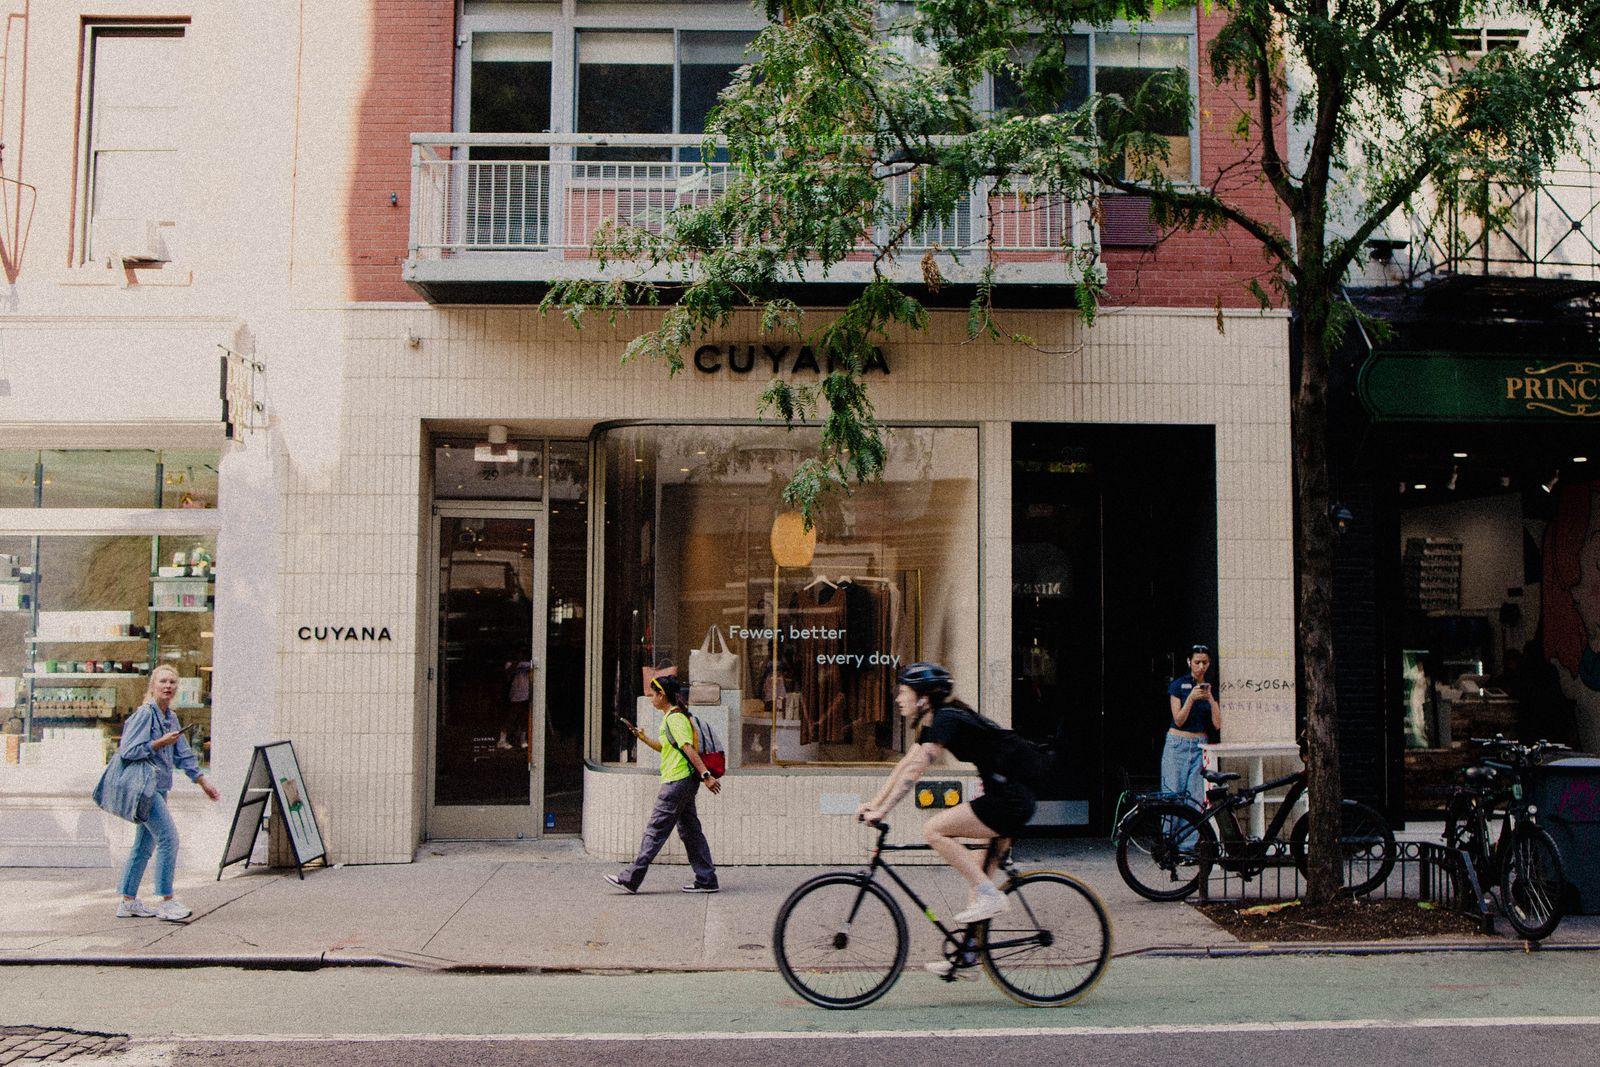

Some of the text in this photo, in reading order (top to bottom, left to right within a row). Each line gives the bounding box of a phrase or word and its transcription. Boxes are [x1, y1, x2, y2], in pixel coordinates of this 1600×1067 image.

[1505, 377, 1600, 400] PRINC
[298, 626, 392, 641] CUYANA
[729, 625, 847, 641] Fewer, better
[816, 651, 901, 668] every day
